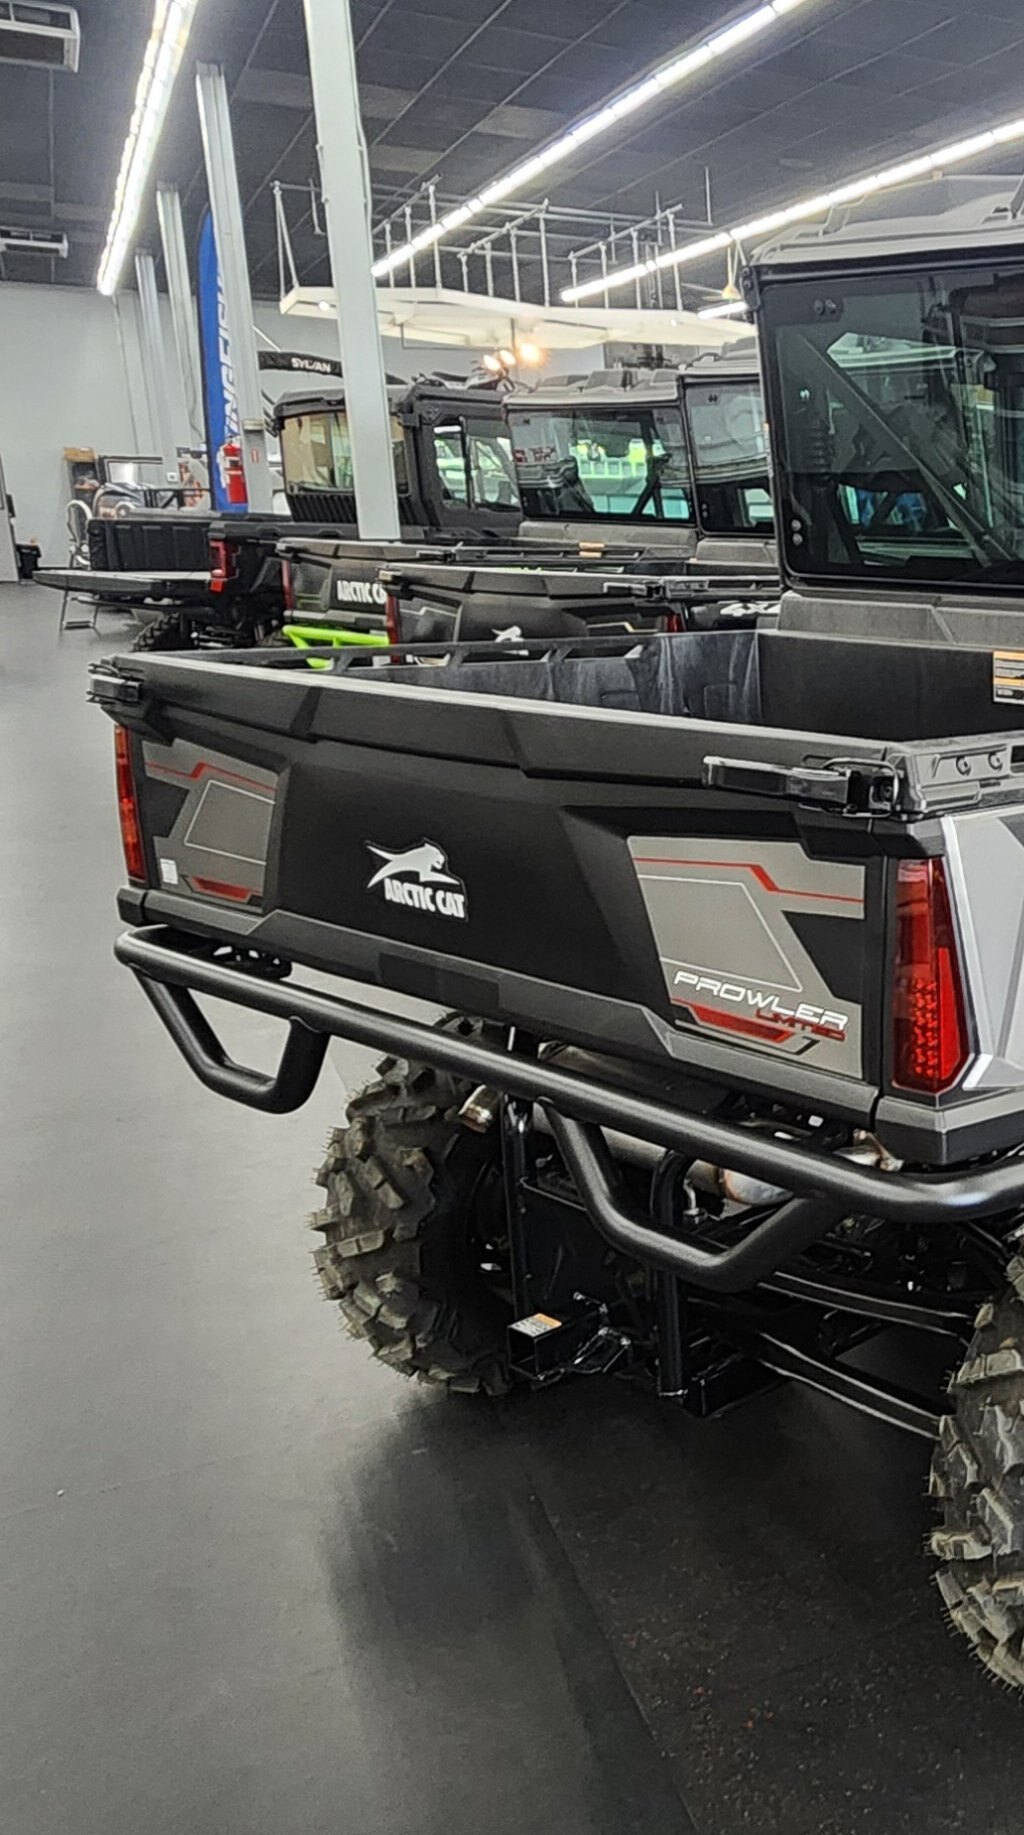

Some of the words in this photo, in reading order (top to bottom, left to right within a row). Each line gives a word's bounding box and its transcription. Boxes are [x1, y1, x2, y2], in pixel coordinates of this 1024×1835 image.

[336, 579, 374, 604] ARCTIC
[383, 877, 436, 913] ARCTIC
[435, 889, 465, 919] CAT
[673, 970, 849, 1031] PROWLER
